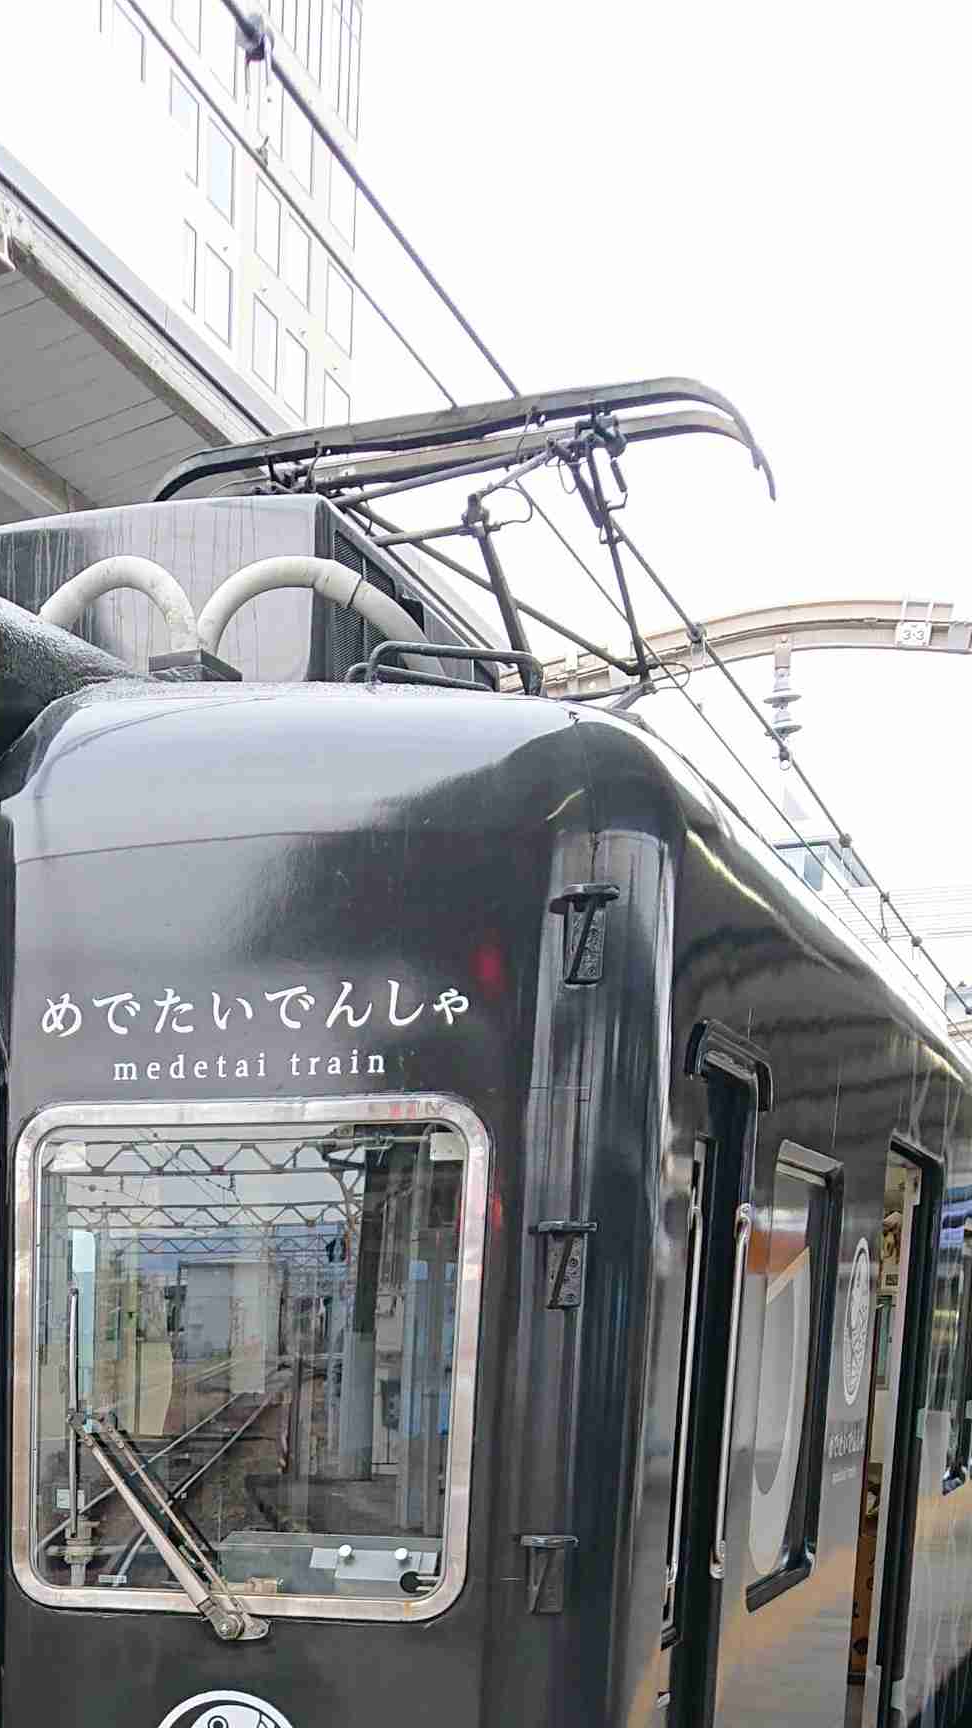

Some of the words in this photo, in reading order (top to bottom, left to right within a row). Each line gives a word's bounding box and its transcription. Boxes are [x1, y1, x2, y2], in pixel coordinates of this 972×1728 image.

[40, 978, 470, 1038] めでたいでんしゃ
[113, 1052, 267, 1081] medetai
[290, 1051, 386, 1077] train
